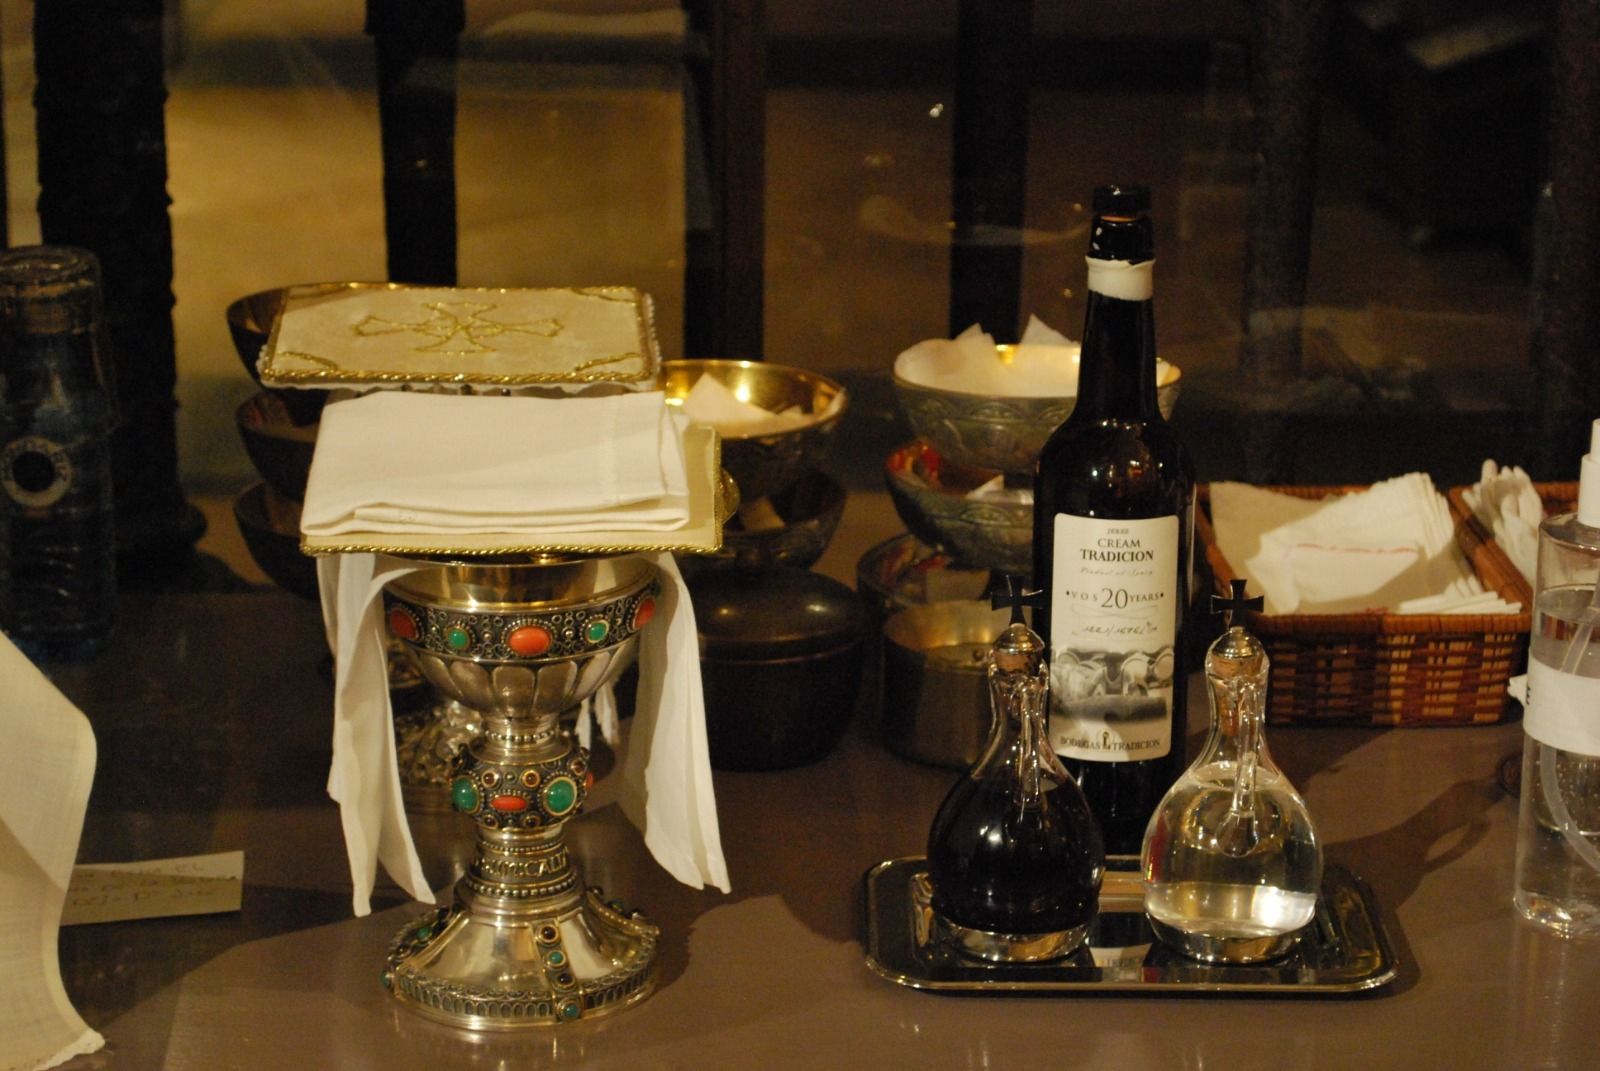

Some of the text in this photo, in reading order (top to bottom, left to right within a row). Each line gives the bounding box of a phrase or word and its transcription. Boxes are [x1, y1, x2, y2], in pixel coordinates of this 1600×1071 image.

[1097, 538, 1141, 549] CREAM
[1080, 548, 1154, 563] TRADICION
[1100, 588, 1129, 609] 20
[1130, 592, 1160, 603] YEARS
[1060, 736, 1161, 751] BODEGAS TRADICION
